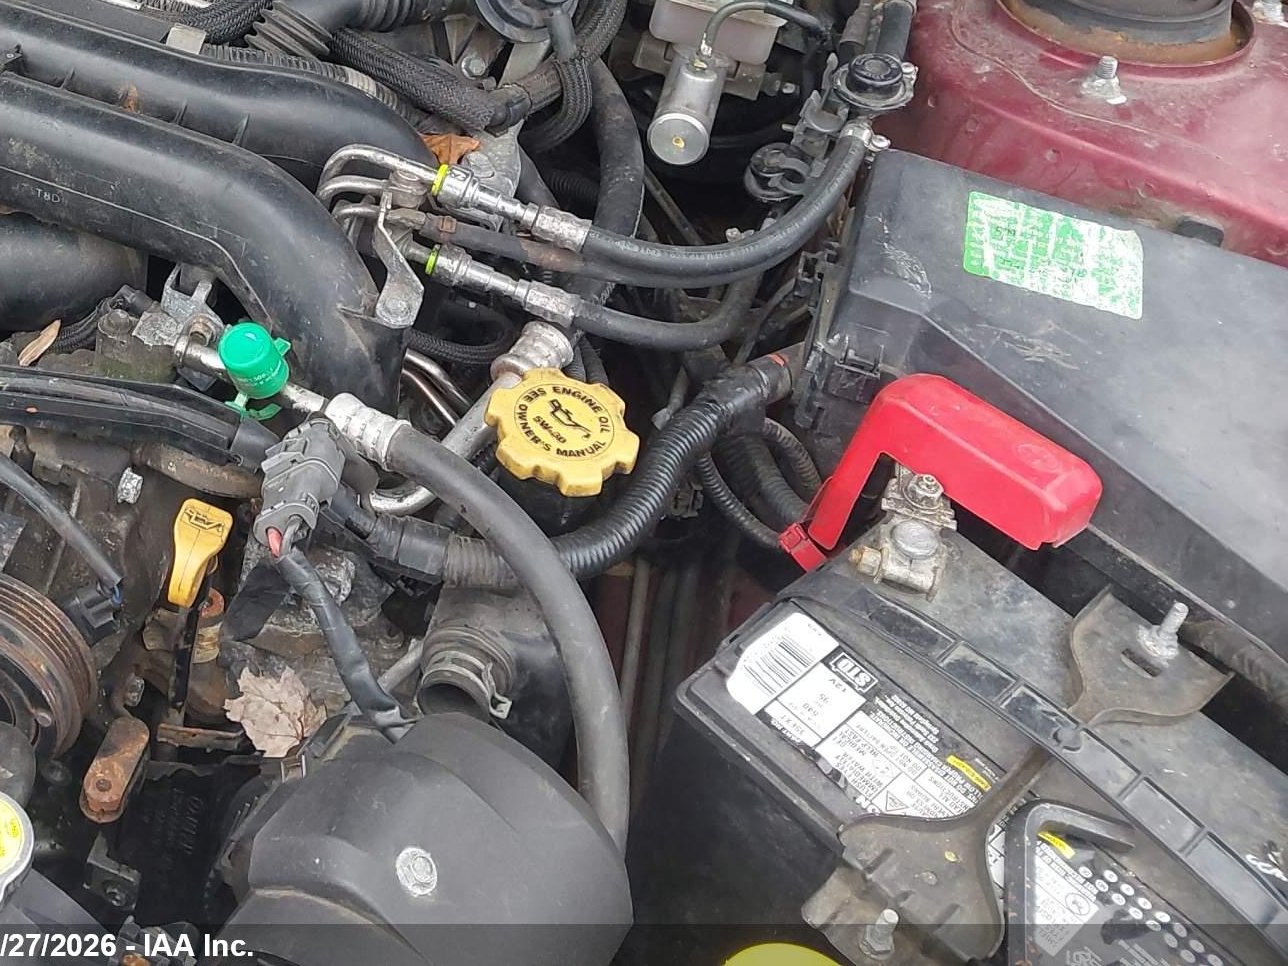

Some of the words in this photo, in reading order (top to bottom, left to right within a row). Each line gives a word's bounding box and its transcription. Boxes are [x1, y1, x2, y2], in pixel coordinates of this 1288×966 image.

[523, 387, 547, 403] SEE
[552, 386, 603, 413] ENGINE
[599, 416, 611, 433] OIL
[517, 403, 552, 451] OWNER'S
[556, 440, 607, 457] MANUAL
[835, 656, 872, 688] STD
